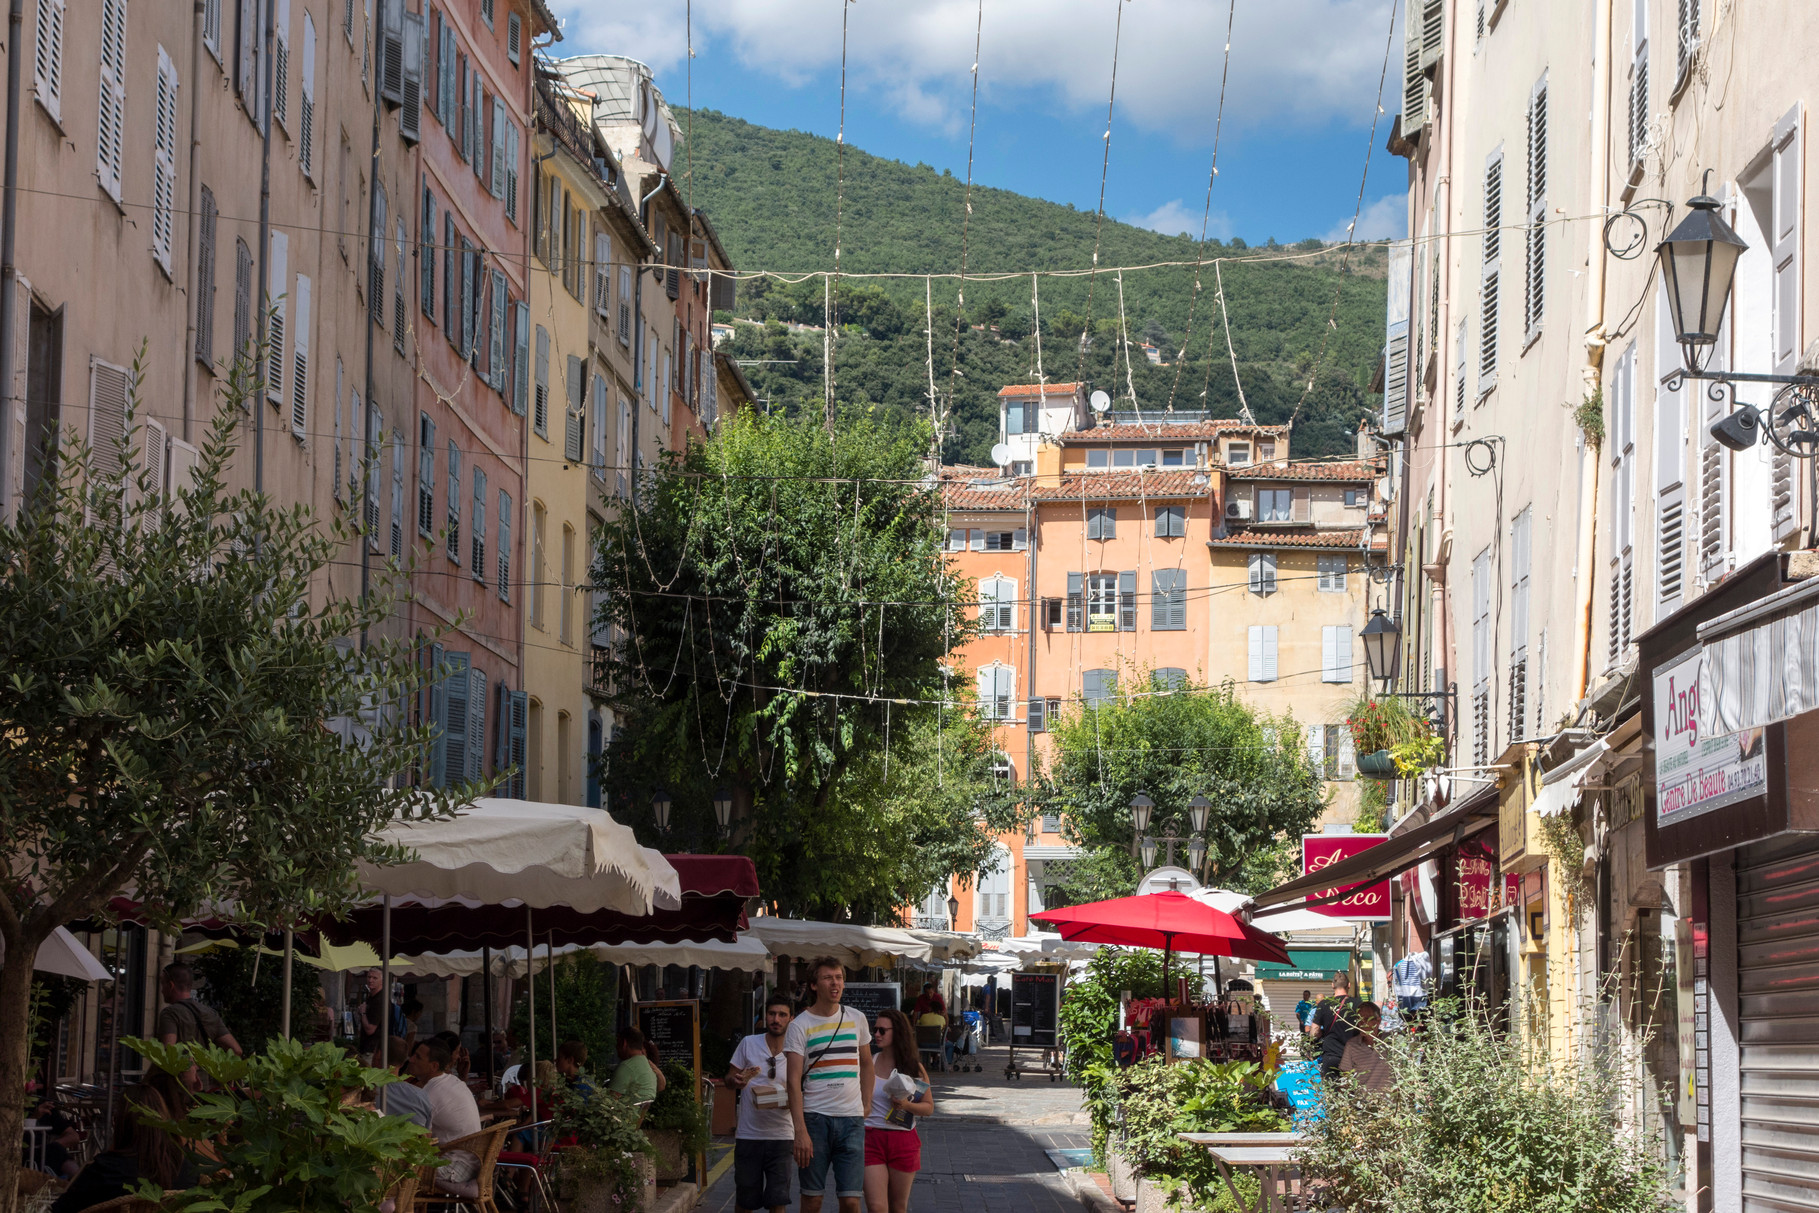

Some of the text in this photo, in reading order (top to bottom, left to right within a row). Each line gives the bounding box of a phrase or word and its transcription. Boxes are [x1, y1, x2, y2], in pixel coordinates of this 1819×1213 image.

[1665, 674, 1702, 748] Ang
[1661, 783, 1685, 814] Centre
[1686, 772, 1698, 804] De
[1698, 766, 1726, 801] Beaute
[1014, 975, 1055, 984] Café Max
